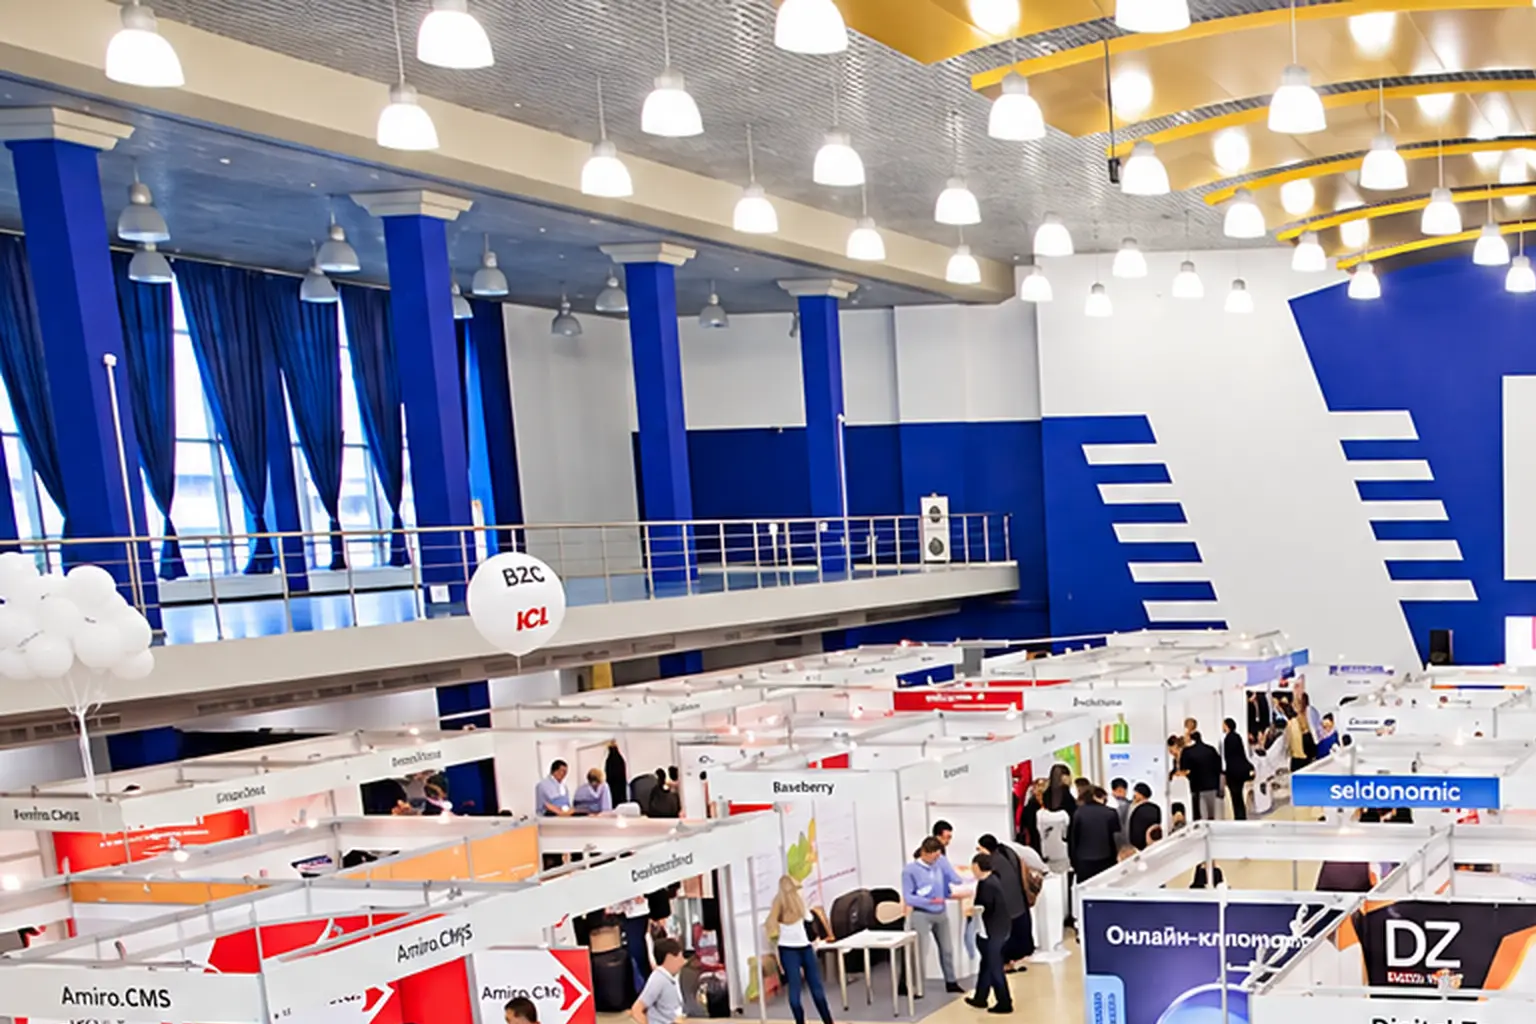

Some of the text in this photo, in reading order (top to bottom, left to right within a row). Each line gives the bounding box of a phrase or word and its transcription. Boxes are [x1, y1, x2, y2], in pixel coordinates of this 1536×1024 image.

[502, 565, 545, 587] B2C
[516, 606, 549, 631] ICL
[1386, 920, 1461, 968] DZ
[61, 986, 171, 1009] Amiro.CMS
